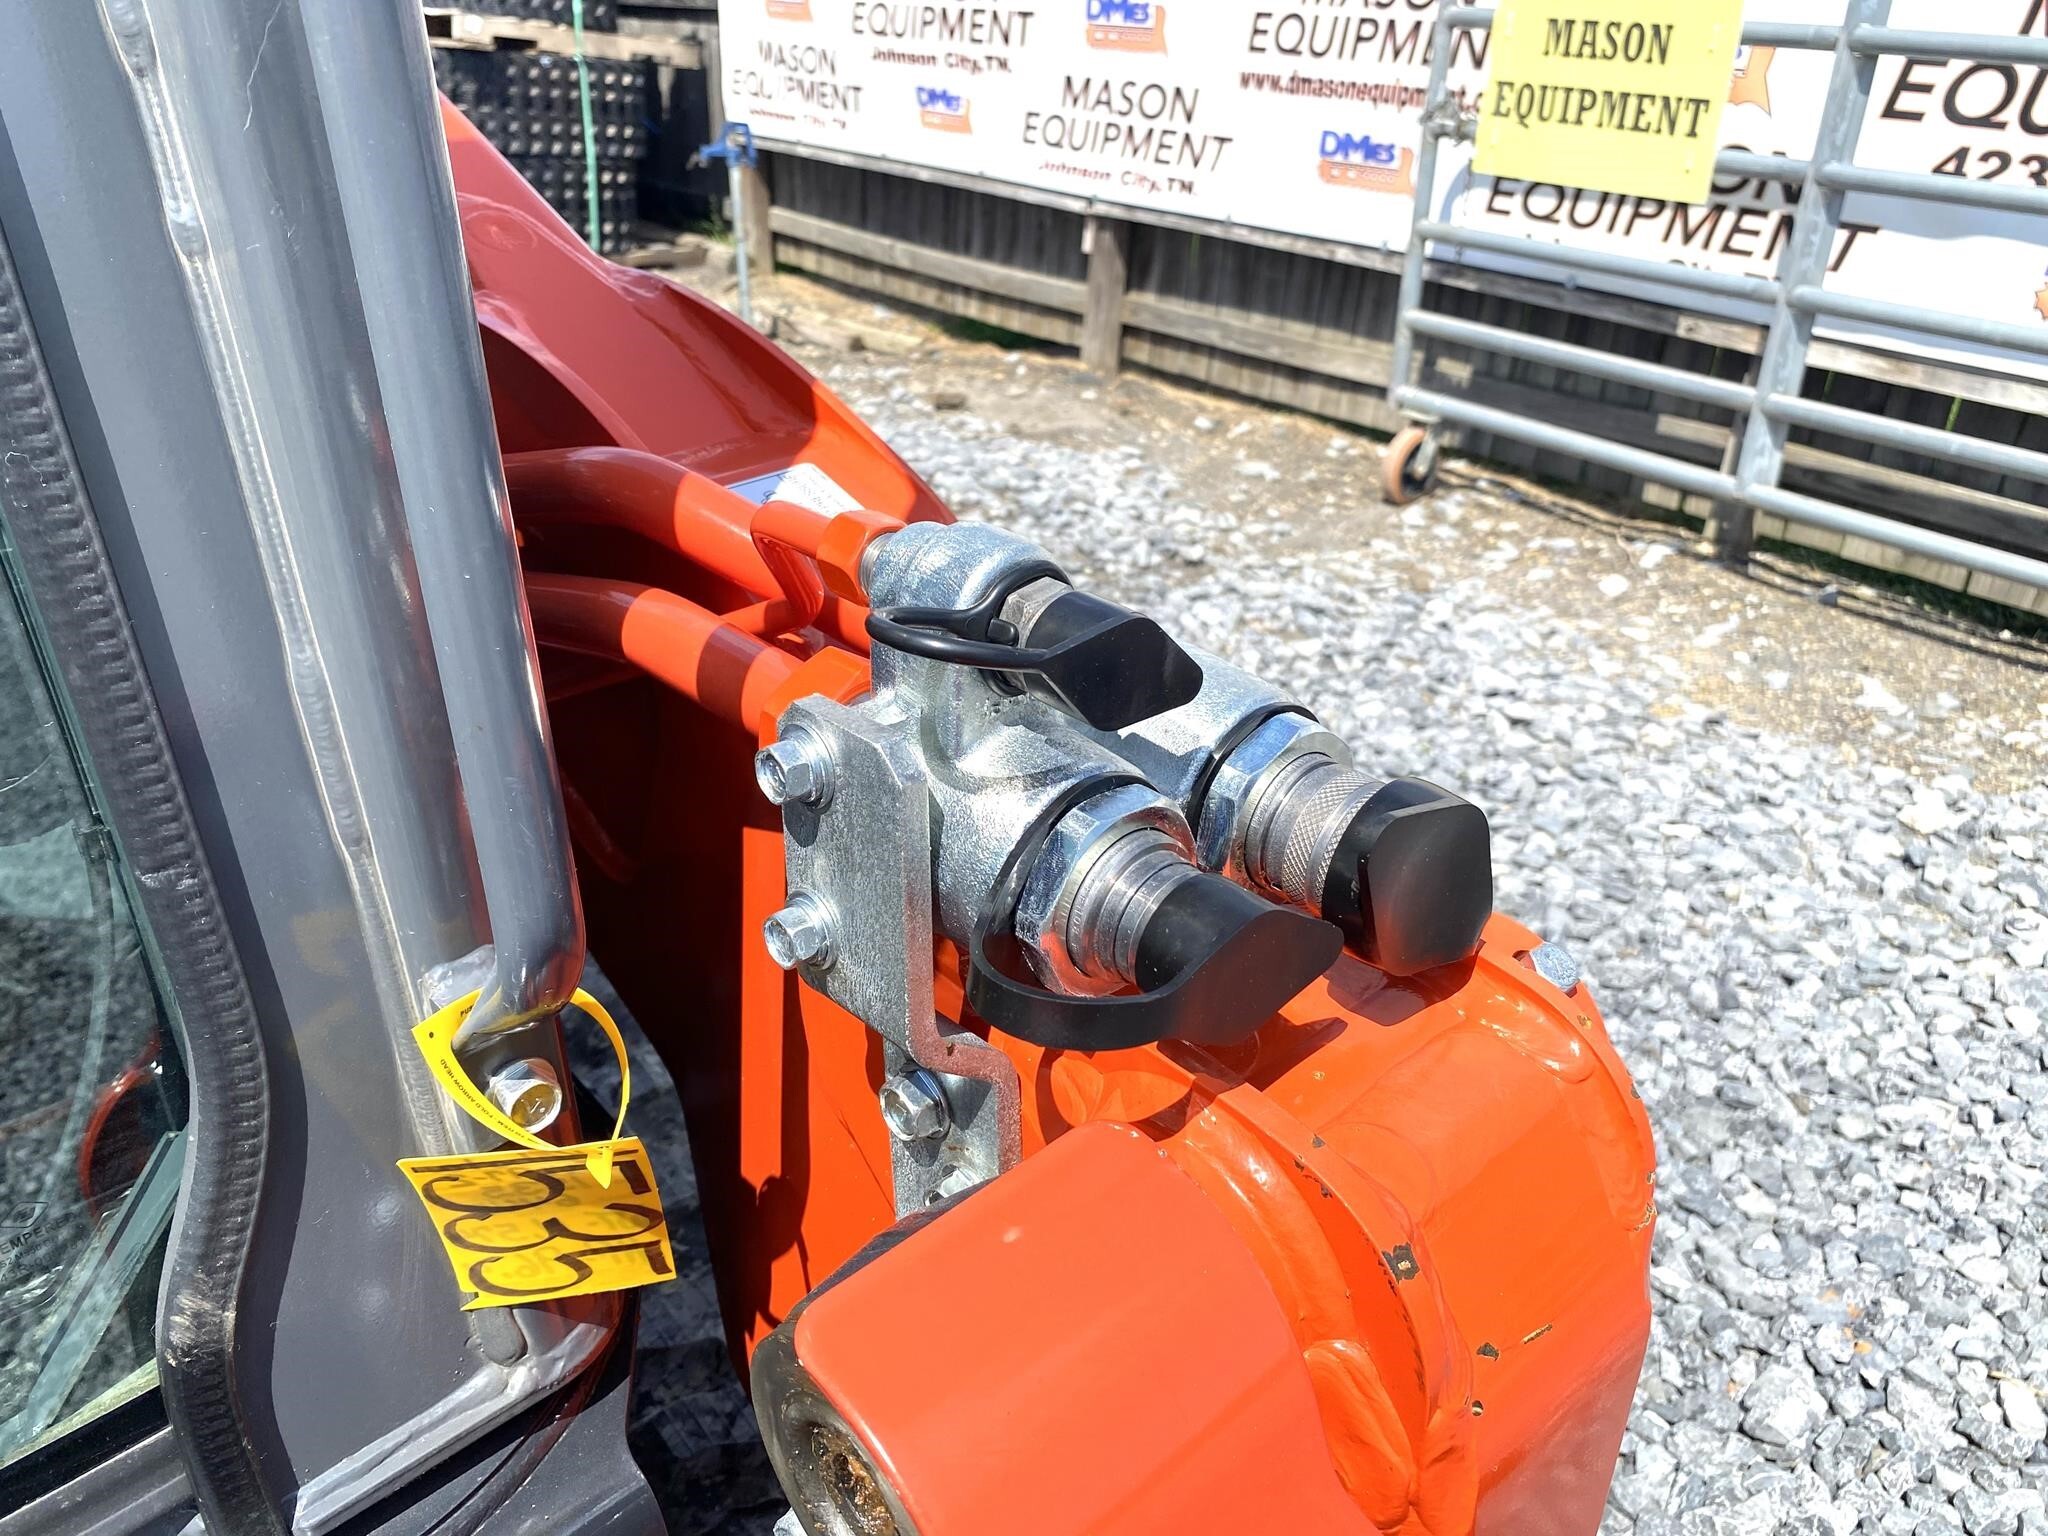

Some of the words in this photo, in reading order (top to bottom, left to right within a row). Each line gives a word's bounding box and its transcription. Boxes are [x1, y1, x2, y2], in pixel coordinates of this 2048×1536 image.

[852, 1, 1035, 48] EQUIPMENT
[1248, 12, 1492, 70] EQUIPMN
[1543, 18, 1674, 65] MASON
[759, 40, 836, 76] MASON
[1062, 75, 1200, 124] MASON
[1240, 70, 1484, 115] www.dmasonequipmt.c
[1491, 80, 1711, 139] EQUIPMENT
[1022, 112, 1234, 172] EQUIPMENT
[440, 1059, 454, 1079] HEAD
[453, 1078, 476, 1104] ARROW
[410, 1148, 673, 1297] 1535
